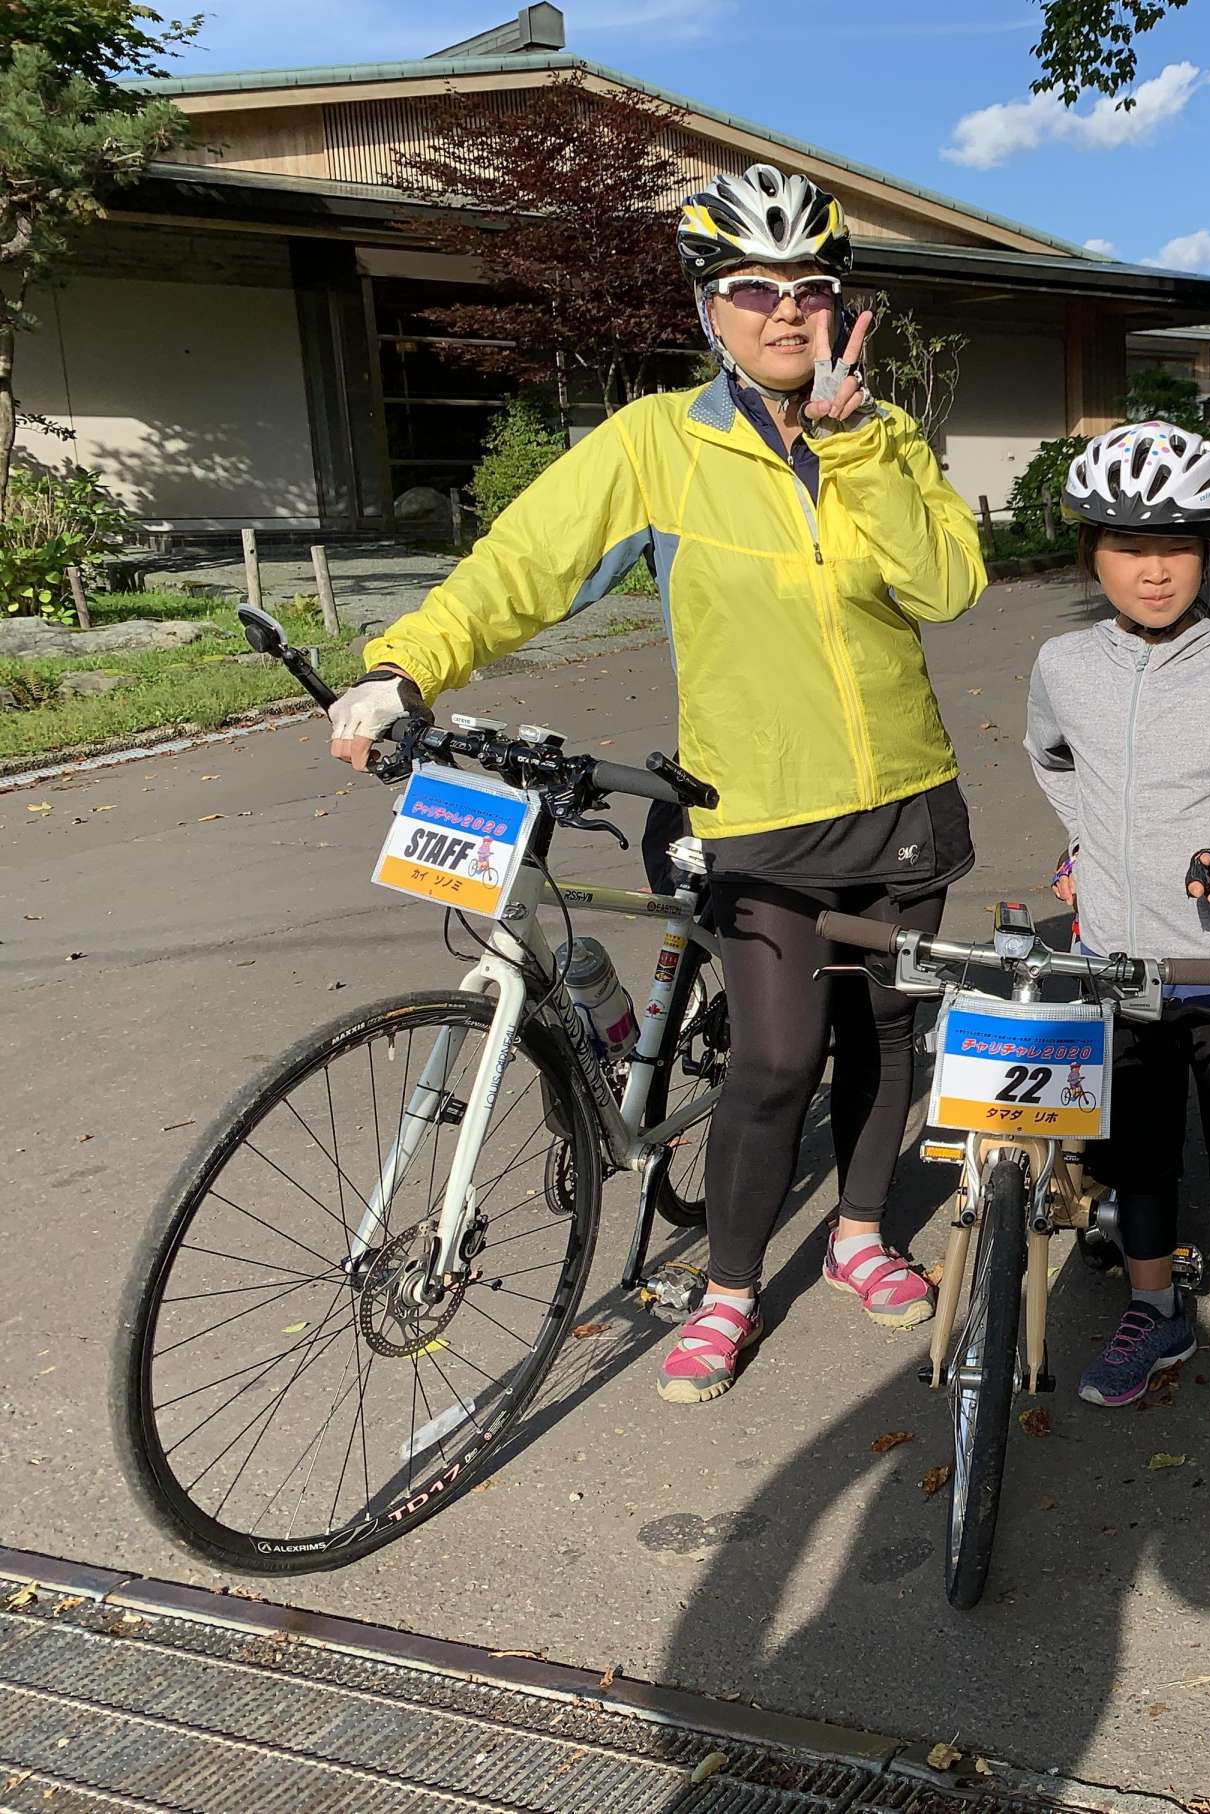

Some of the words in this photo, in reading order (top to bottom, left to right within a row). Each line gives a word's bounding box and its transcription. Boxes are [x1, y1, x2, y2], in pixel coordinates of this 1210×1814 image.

[411, 801, 508, 836] チャリチャレ2020
[403, 827, 476, 871] STAFF
[411, 869, 429, 881] カイ
[434, 876, 463, 892] ソノミ
[331, 1022, 366, 1045] MAXXIS
[961, 1038, 1093, 1060] チャリチャレ2020
[483, 1074, 502, 1110] LOUIS
[995, 1065, 1053, 1104] 22
[985, 1107, 1024, 1121] タマダ
[1033, 1111, 1060, 1123] リホ
[388, 1463, 461, 1522] TD17
[273, 1541, 327, 1553] ALEXRIMS
